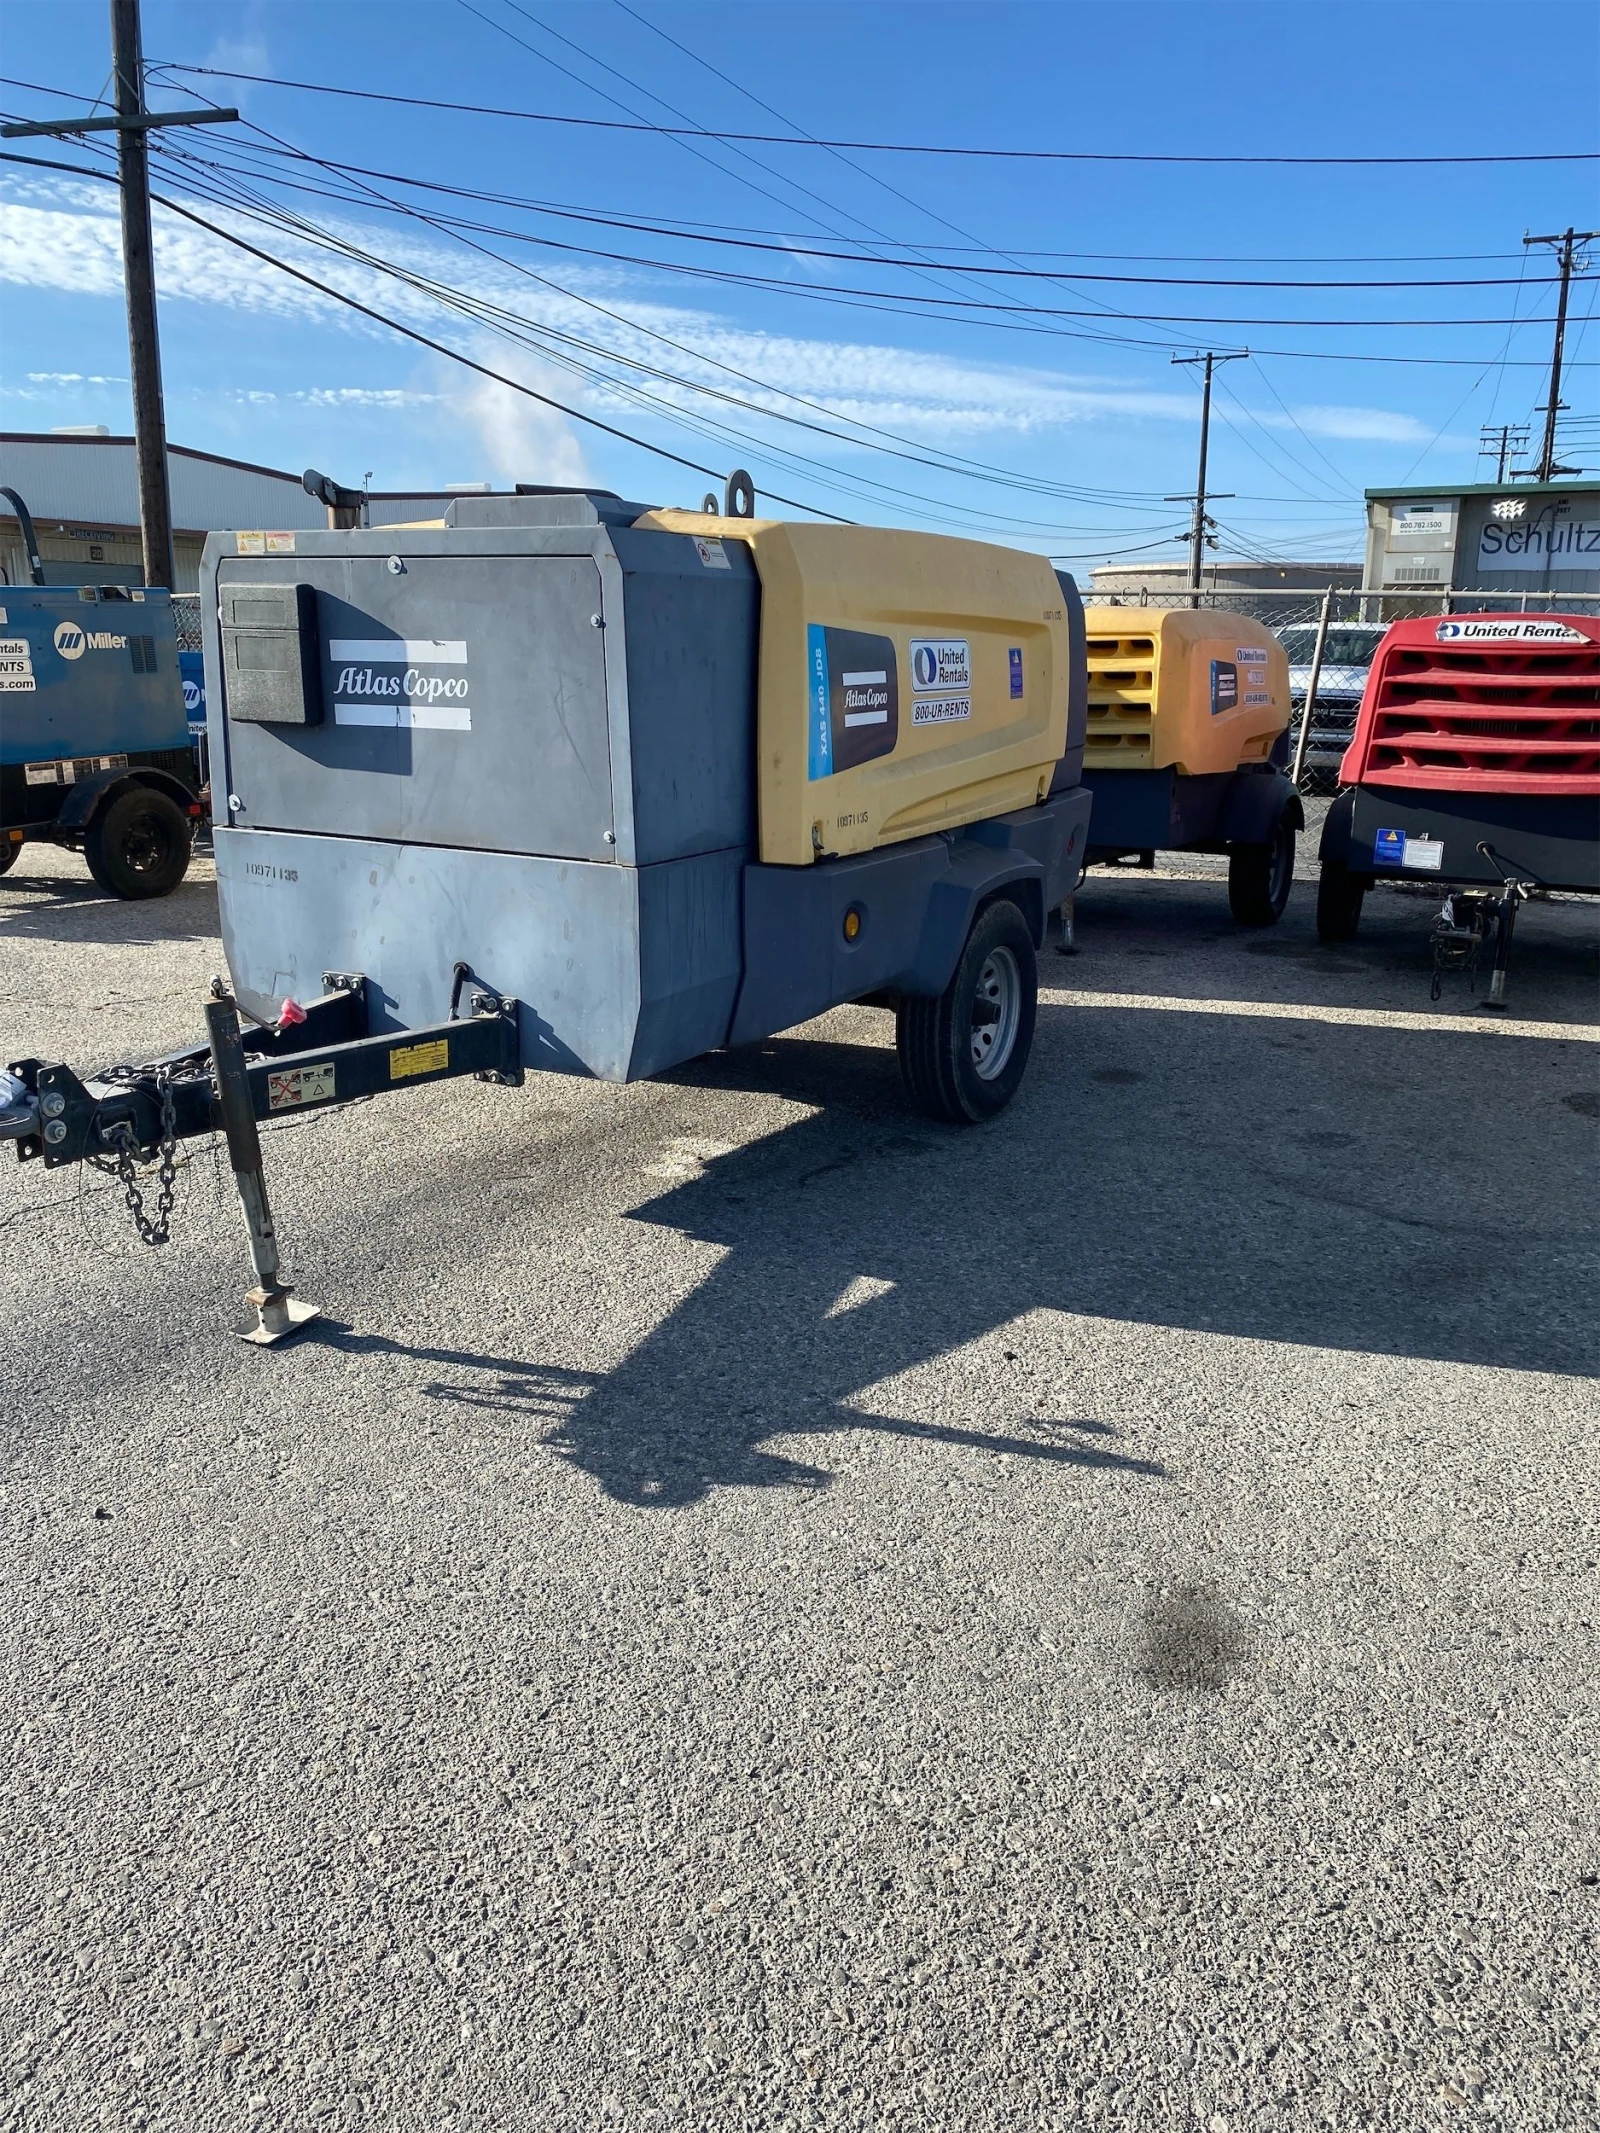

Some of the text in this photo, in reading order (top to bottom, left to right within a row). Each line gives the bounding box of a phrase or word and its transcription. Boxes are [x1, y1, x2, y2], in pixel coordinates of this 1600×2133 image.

[76, 528, 114, 540] RECEIVING
[1400, 521, 1442, 529] 800.782.1500
[1481, 522, 1600, 554] Schultz
[1463, 624, 1571, 638] United Renta
[87, 632, 127, 649] Miller
[938, 648, 965, 665] United
[939, 666, 969, 683] Rentals
[334, 667, 469, 703] Atlas Copco
[817, 686, 826, 716] 440
[844, 688, 888, 709] Atlas Copco
[915, 701, 969, 720] 800-UR-RENTS
[820, 723, 828, 756] XAS
[246, 863, 299, 881] 10971135
